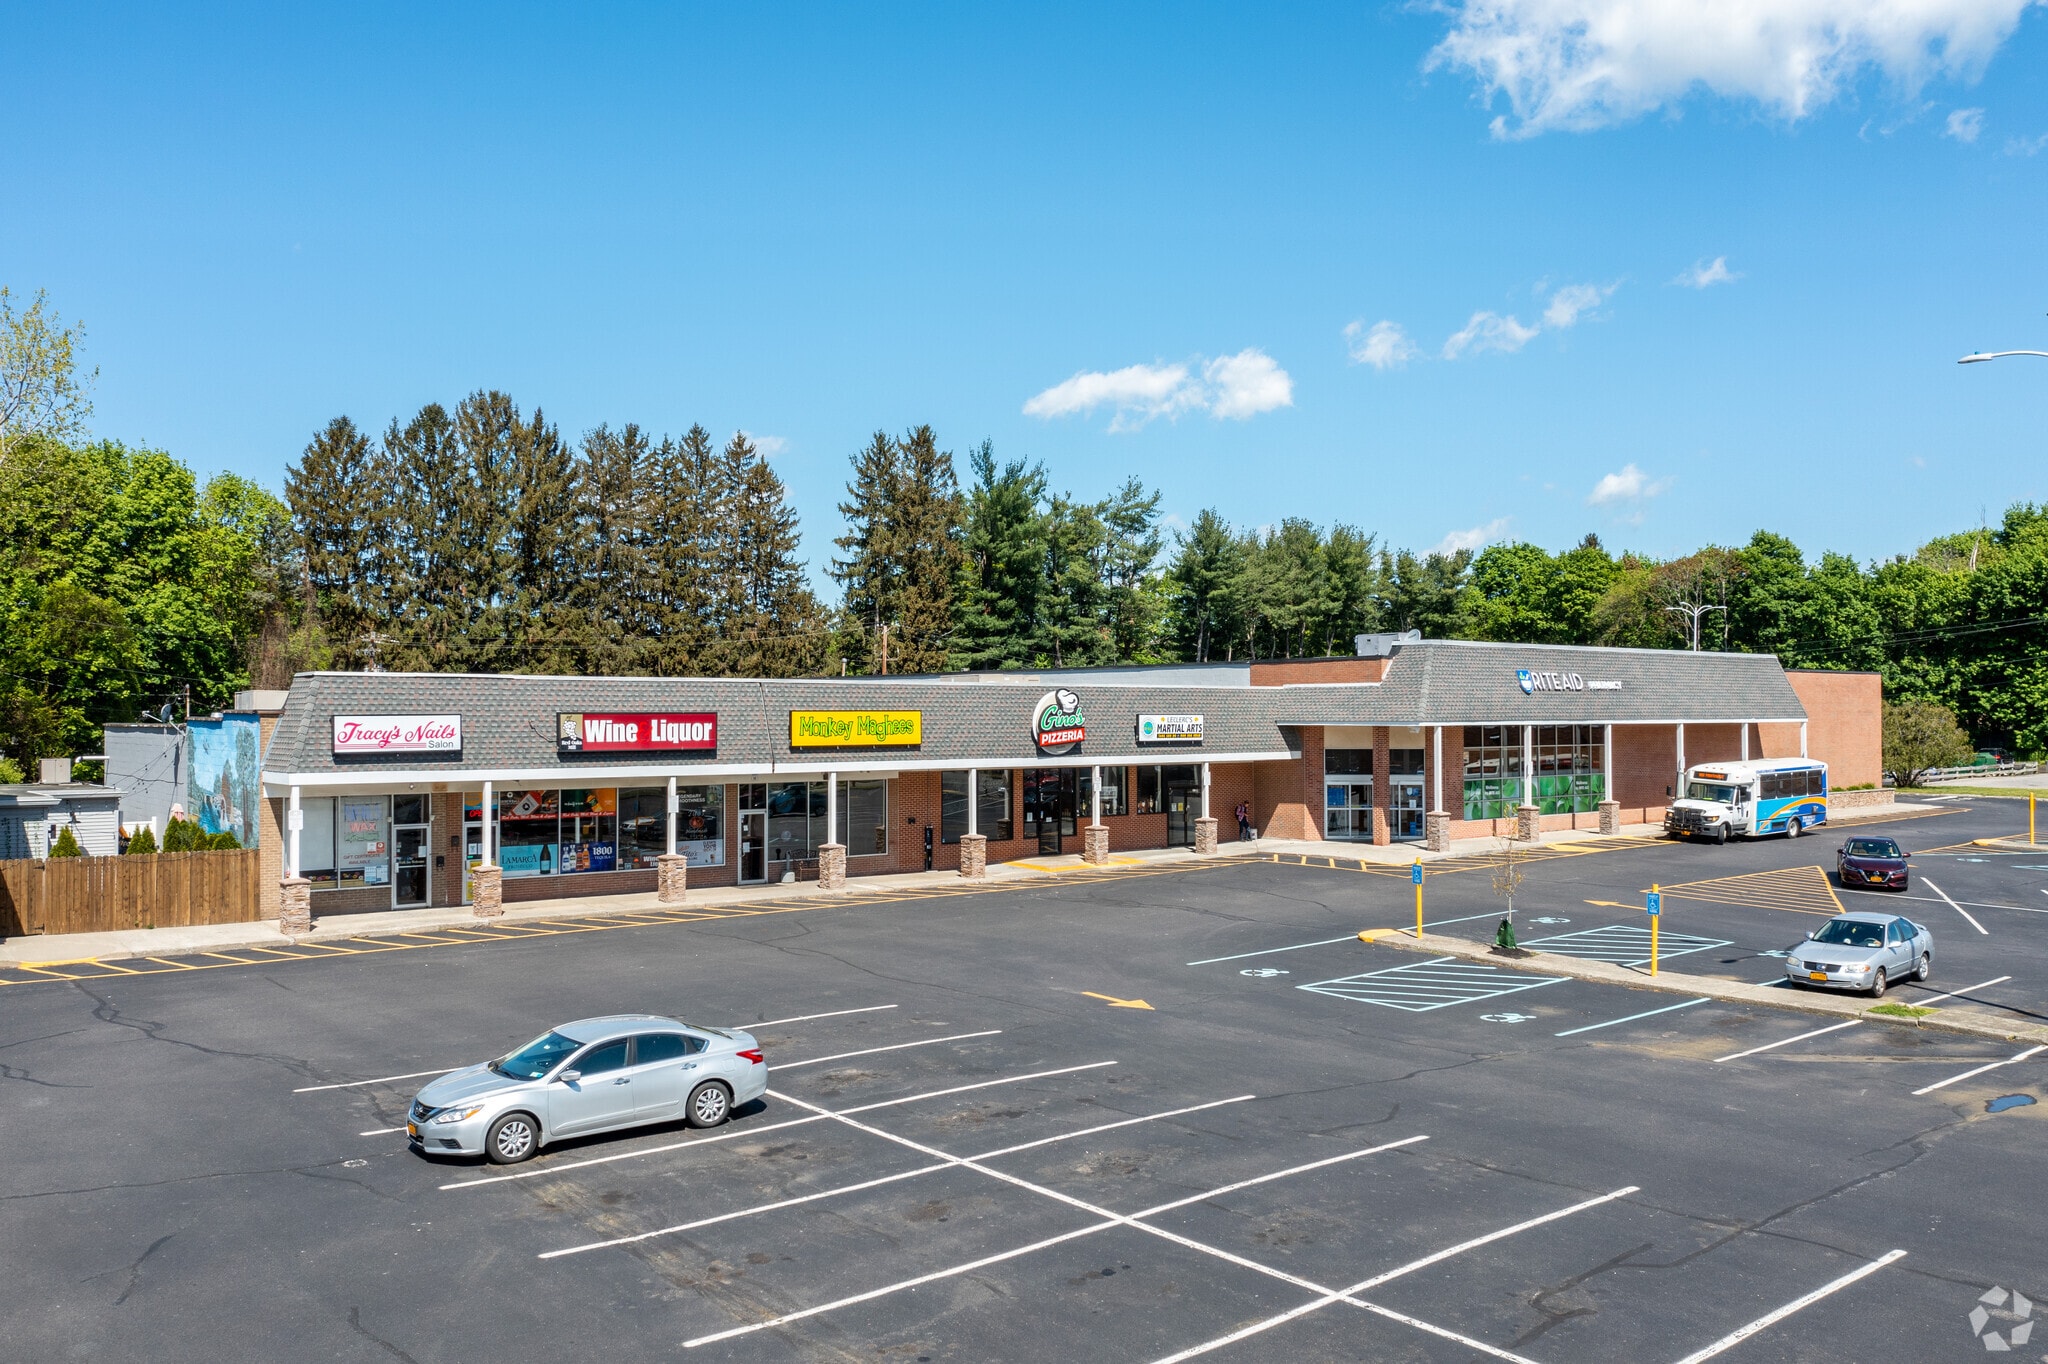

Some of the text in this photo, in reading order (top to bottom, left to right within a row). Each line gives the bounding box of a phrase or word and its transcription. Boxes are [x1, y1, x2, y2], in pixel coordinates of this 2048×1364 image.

[1531, 672, 1562, 690] RITE
[1562, 673, 1583, 690] AID
[1041, 705, 1085, 730] Gino's
[337, 721, 456, 749] Tracy's Nails
[584, 720, 638, 743] Wine
[651, 719, 713, 744] Liquor
[800, 715, 914, 741] Monkey Maghees
[1157, 724, 1184, 733] MARTIAL
[1187, 723, 1203, 733] ARTS
[428, 740, 454, 749] Salon
[1041, 729, 1083, 745] PIZZERIA
[469, 809, 483, 818] OPE
[593, 846, 613, 855] 1800
